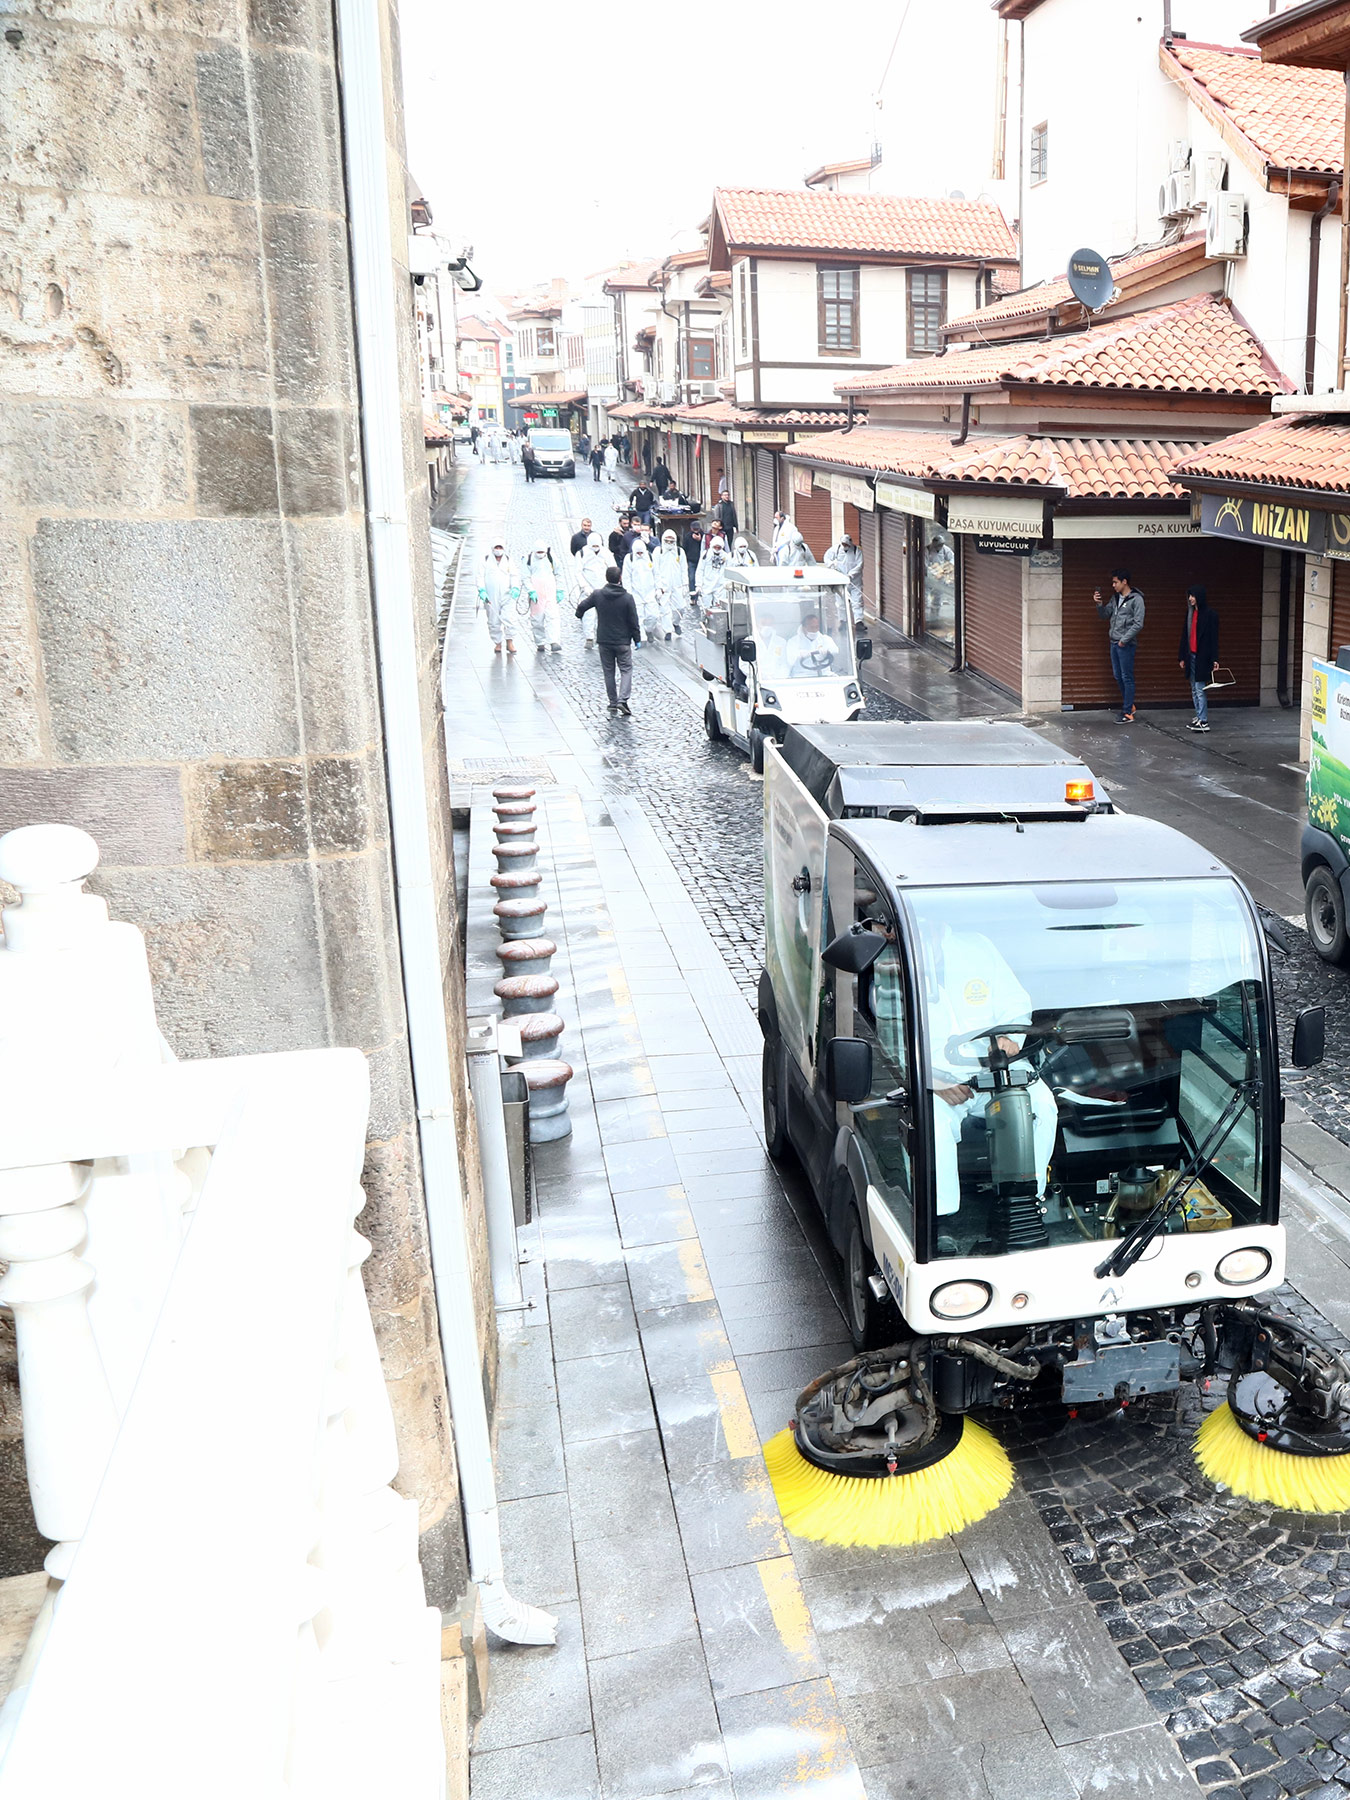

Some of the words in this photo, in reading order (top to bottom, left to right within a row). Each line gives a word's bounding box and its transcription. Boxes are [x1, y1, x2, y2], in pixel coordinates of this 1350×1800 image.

[949, 518, 974, 531] PAŞA
[977, 520, 1041, 533] KUYUMCULUK
[1137, 523, 1164, 535] PAŞA
[978, 541, 1029, 550] KUYUMCULUK
[1333, 792, 1343, 805] YOL
